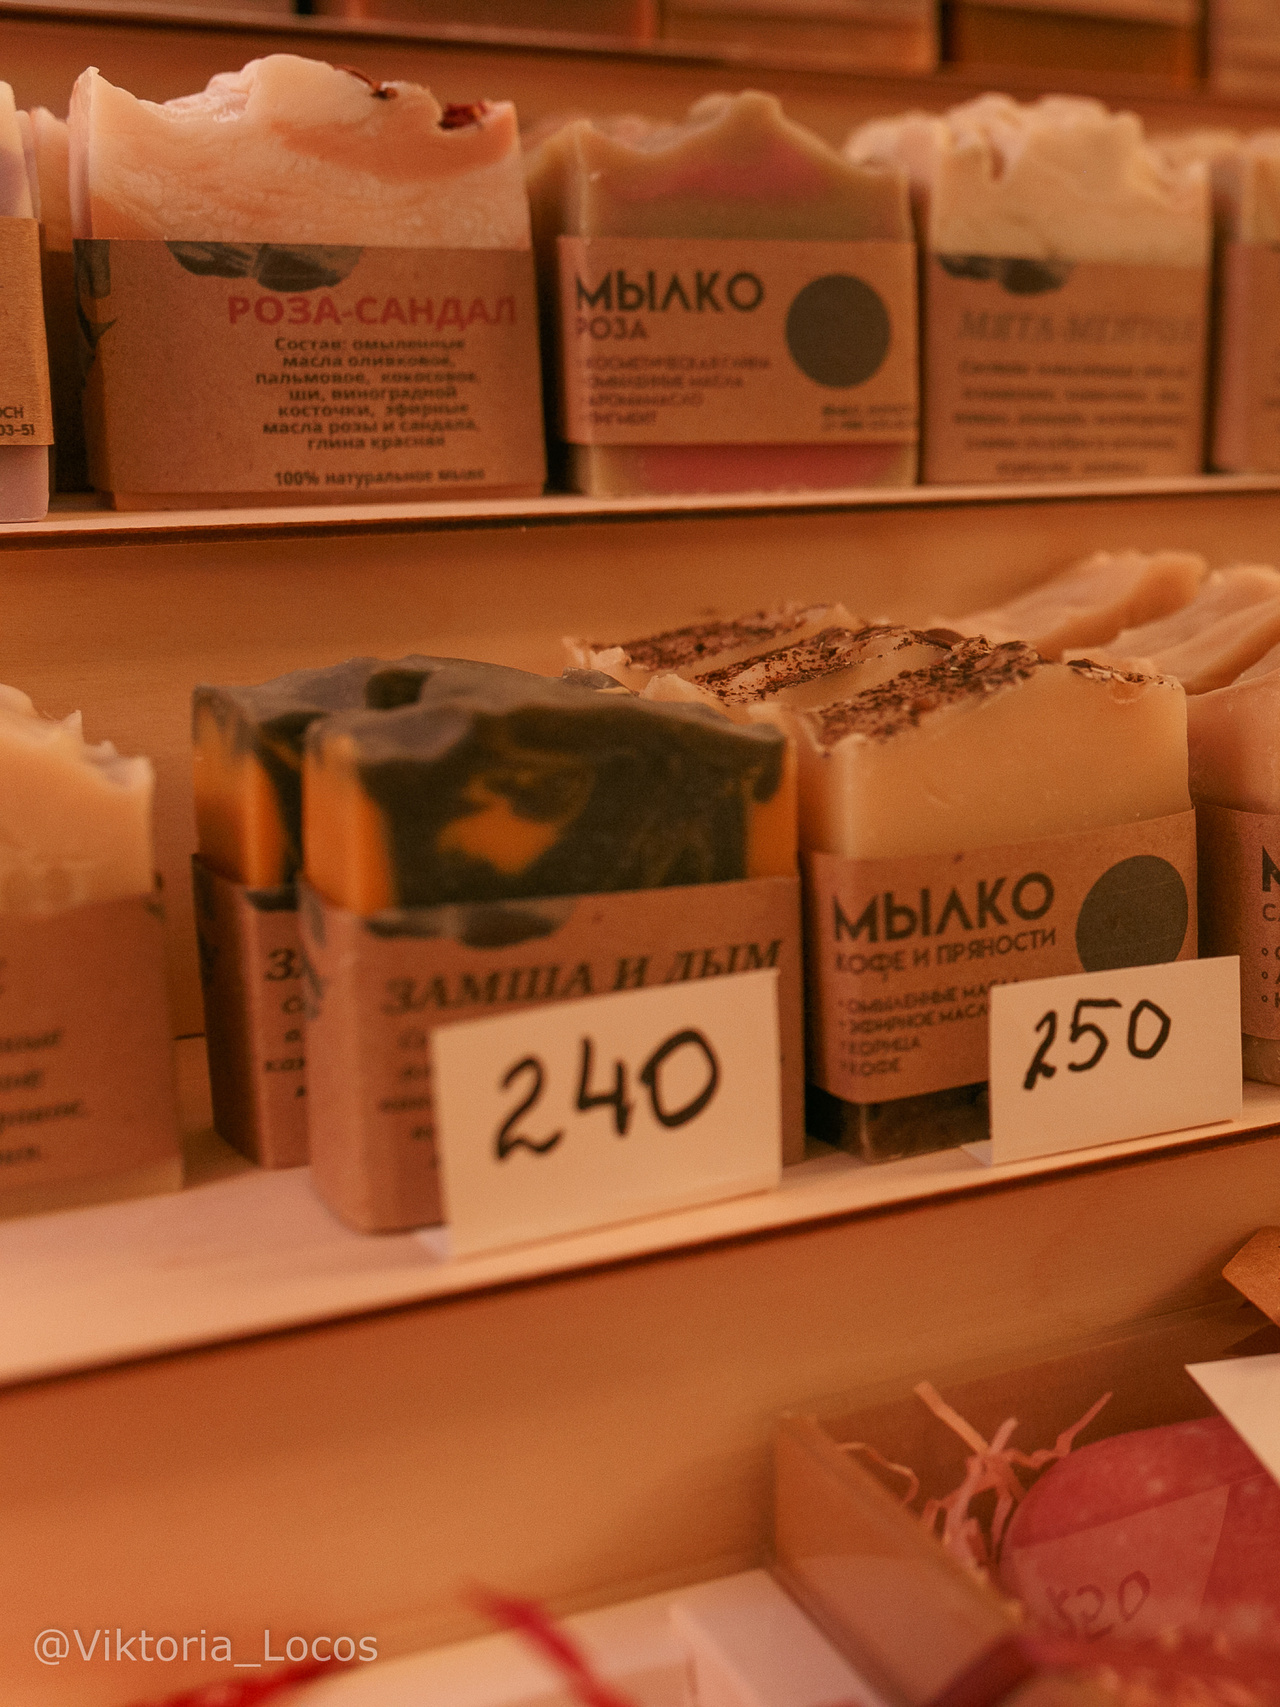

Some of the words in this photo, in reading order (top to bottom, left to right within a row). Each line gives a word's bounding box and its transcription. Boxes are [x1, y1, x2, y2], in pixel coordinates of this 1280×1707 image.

[575, 271, 765, 313] МЫЛКО
[227, 295, 517, 331] РОЗА-САНДАЛ
[574, 317, 649, 340] РОЗА
[283, 355, 342, 368] масла
[262, 421, 324, 435] масла
[332, 420, 379, 437] розы
[383, 421, 401, 435] и
[307, 436, 366, 451] глина
[274, 470, 320, 487] 100%
[832, 871, 1056, 944] МЫЛКО
[835, 950, 908, 983] КОФЕ
[912, 945, 931, 970] И
[936, 928, 1056, 962] ПРЯНОСТИ
[381, 961, 597, 1017] ЗАМША
[1023, 997, 1171, 1091] 250
[494, 1028, 721, 1161] 240
